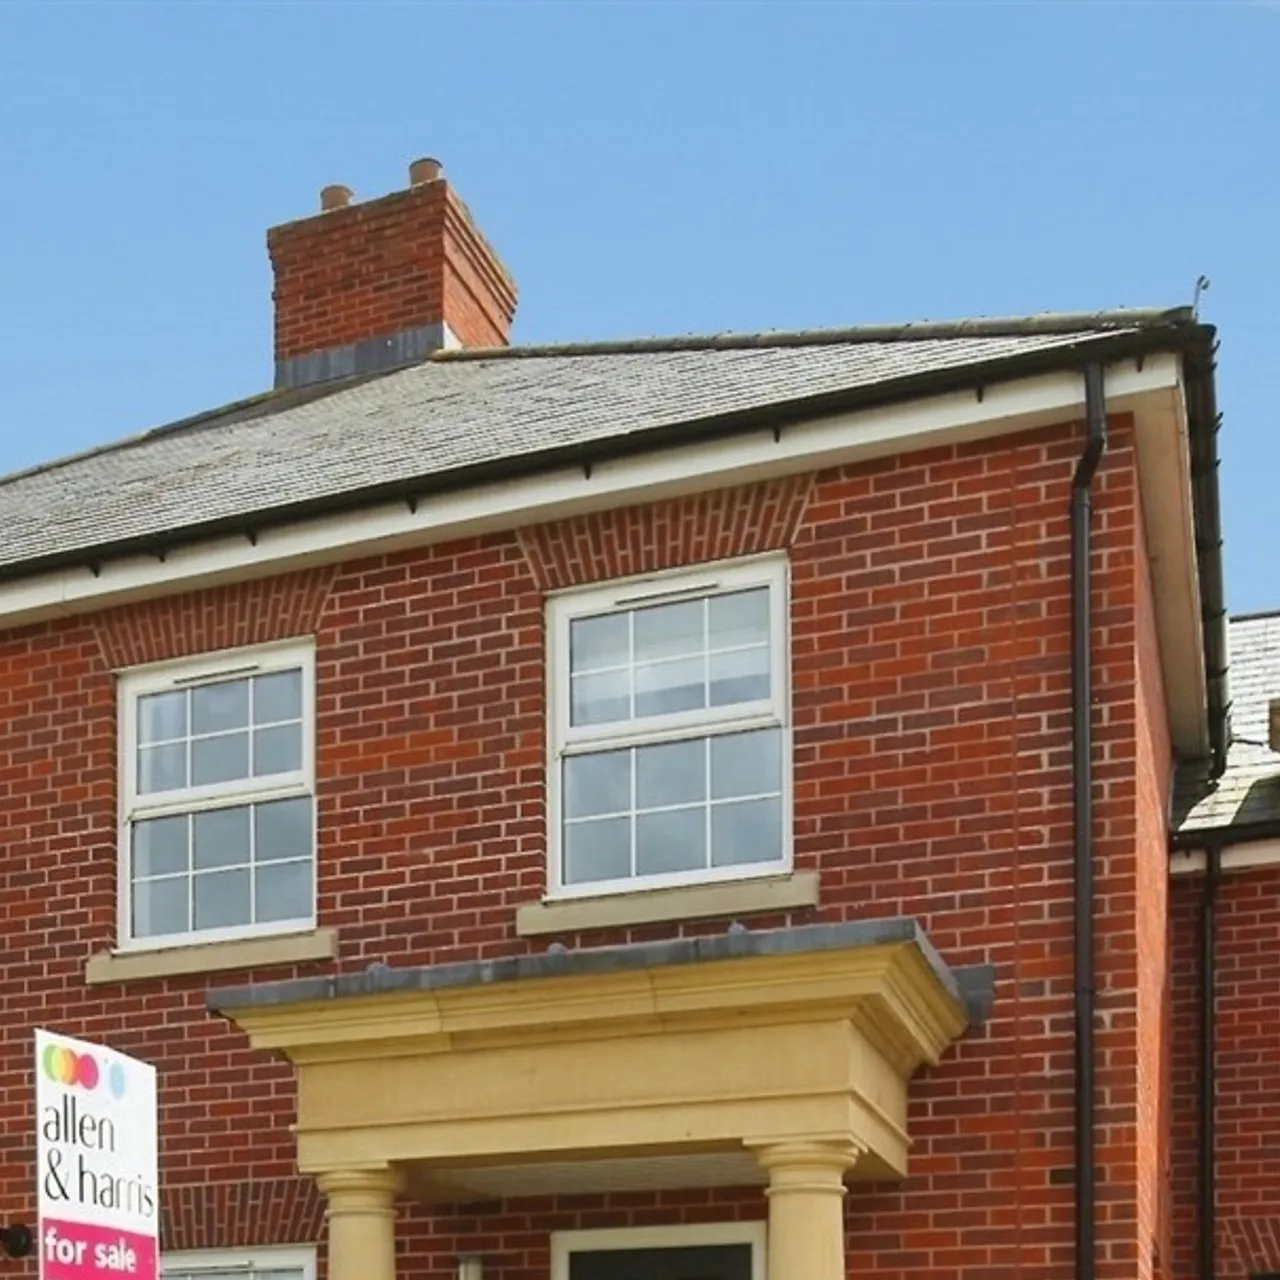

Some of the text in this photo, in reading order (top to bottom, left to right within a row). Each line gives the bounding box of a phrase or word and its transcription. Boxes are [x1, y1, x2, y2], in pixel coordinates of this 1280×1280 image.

[43, 1093, 115, 1152] allen
[44, 1148, 154, 1218] & harris
[45, 1227, 137, 1274] for sale
